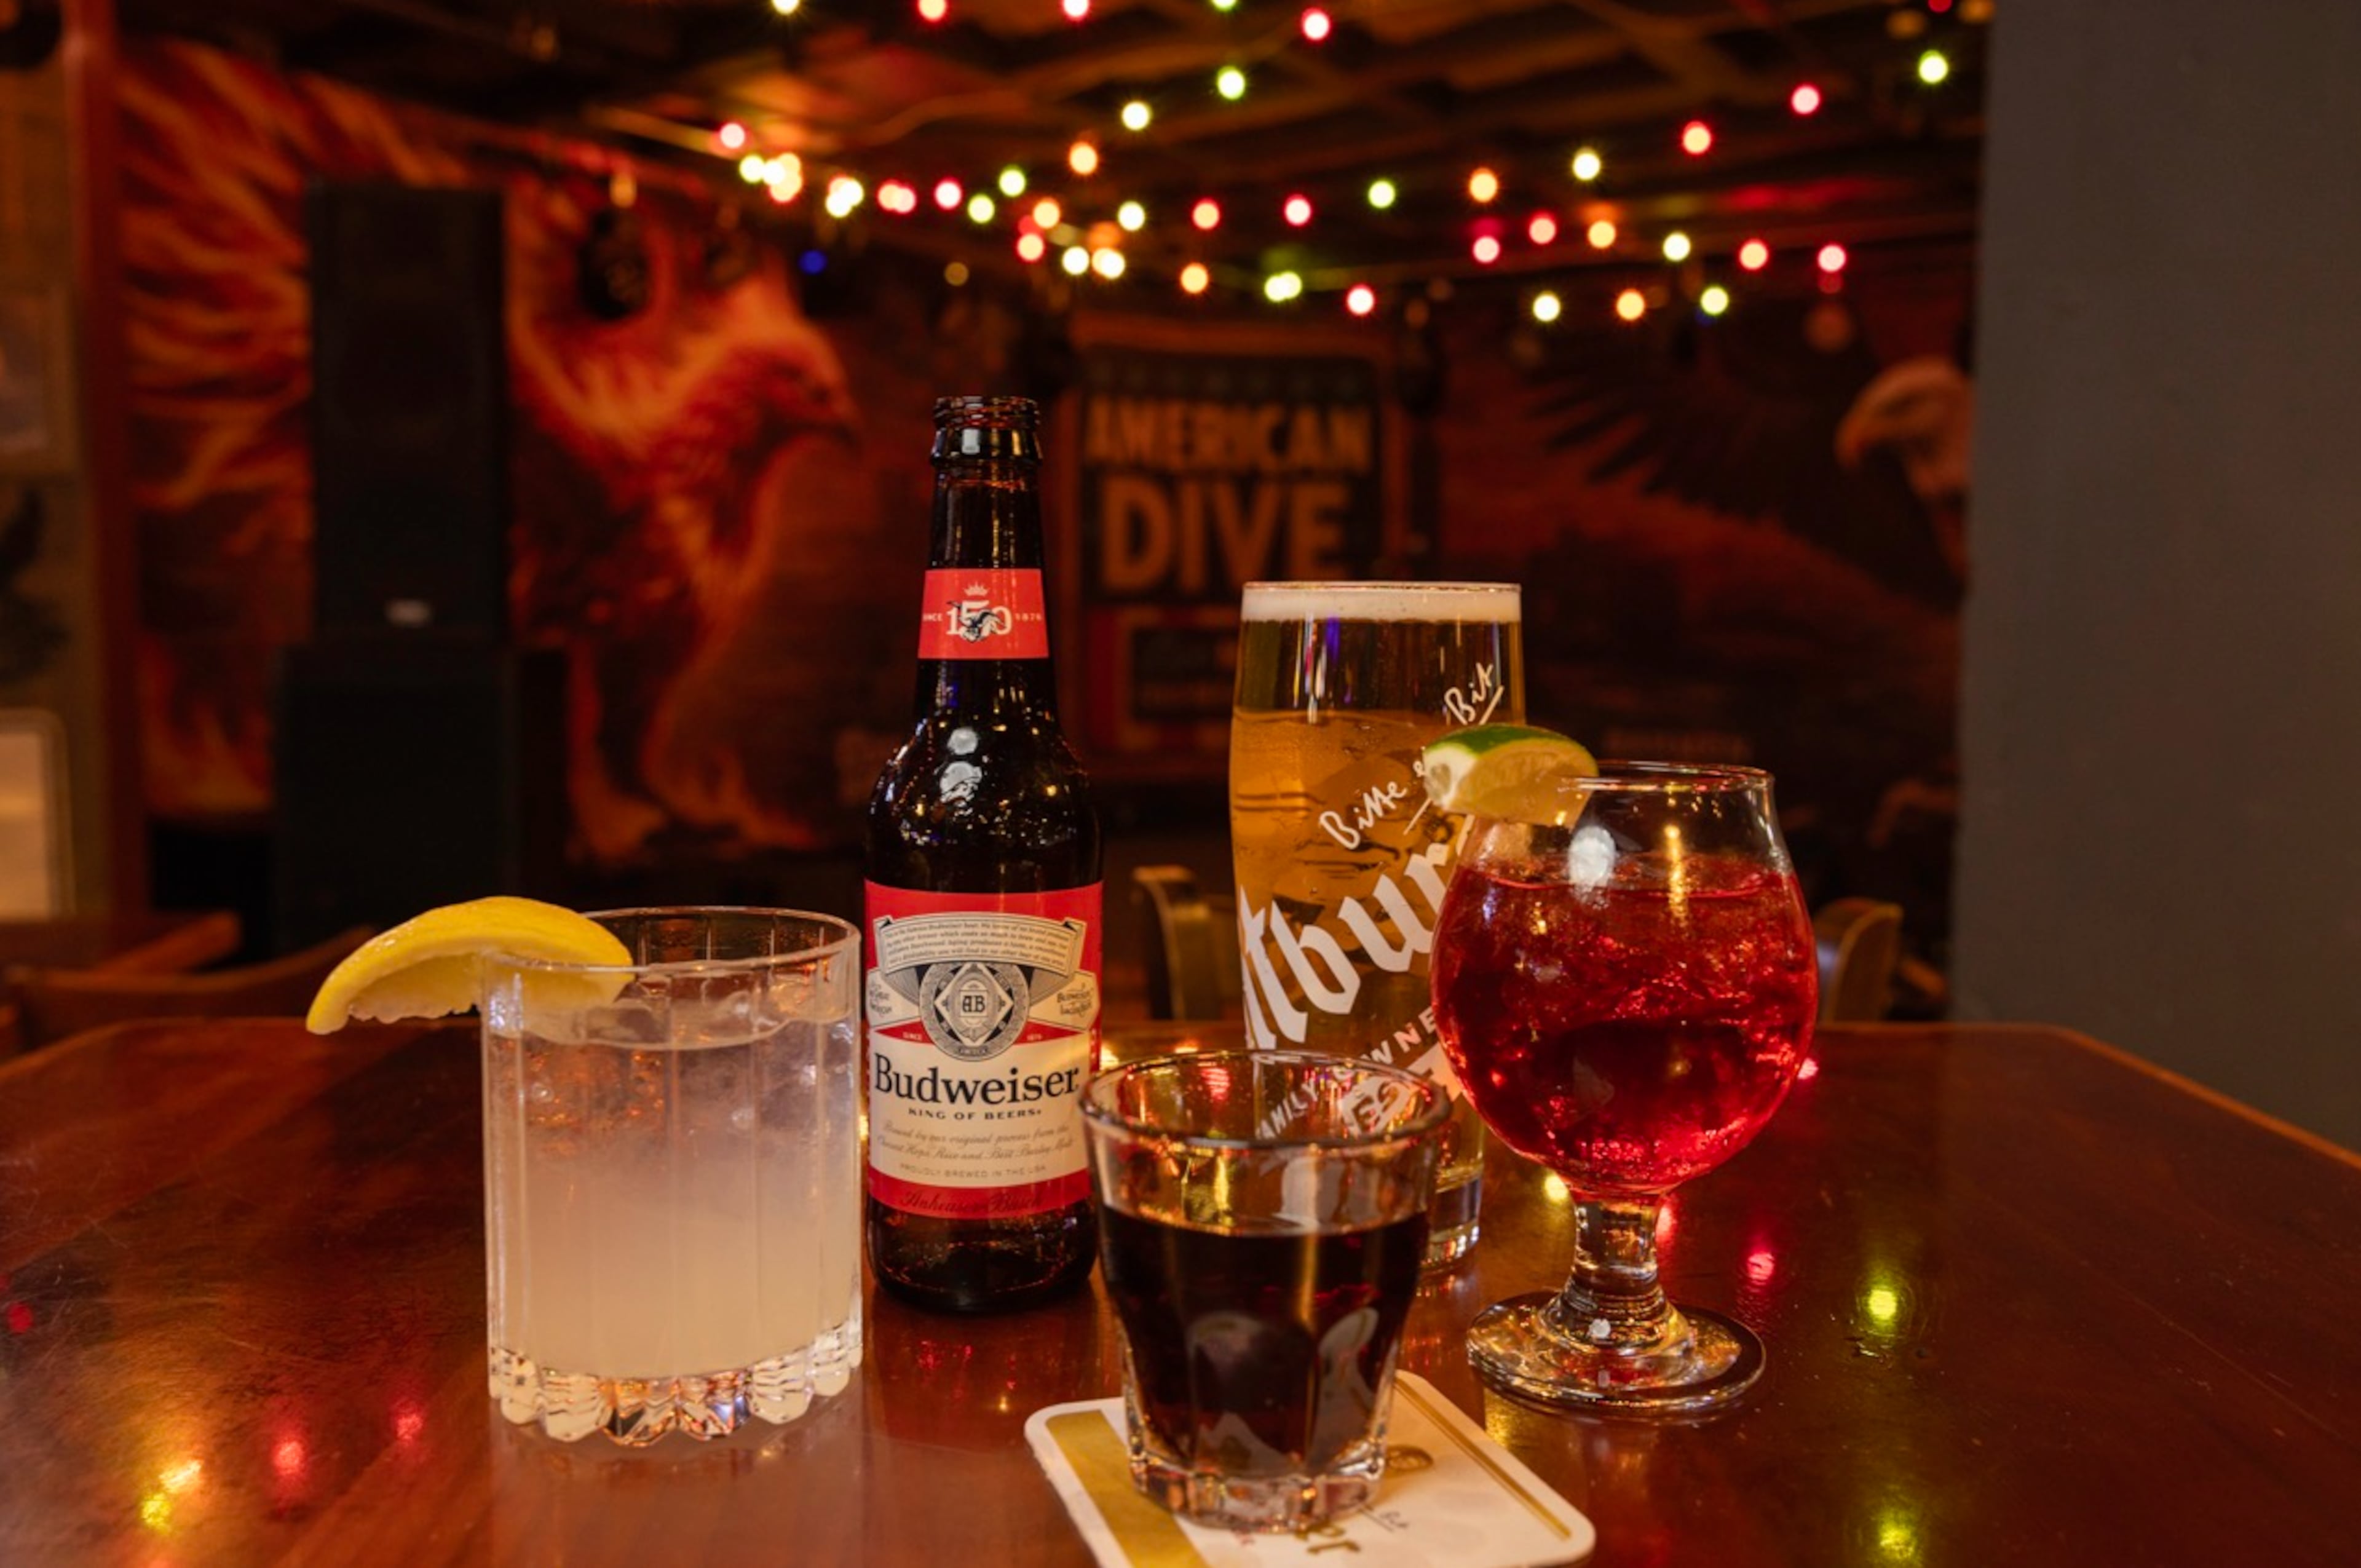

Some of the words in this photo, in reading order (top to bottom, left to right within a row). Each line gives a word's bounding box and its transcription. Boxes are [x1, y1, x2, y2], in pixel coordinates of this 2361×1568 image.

[1085, 397, 1372, 471] AMERICAN
[1102, 476, 1348, 593] DIVE
[945, 600, 1013, 636] 150
[1319, 782, 1407, 850] Bitte
[1444, 662, 1493, 725] Bit
[962, 995, 986, 1013] AB
[874, 1052, 1080, 1106] Budweiser
[908, 1107, 946, 1120] KING
[954, 1112, 976, 1120] OF
